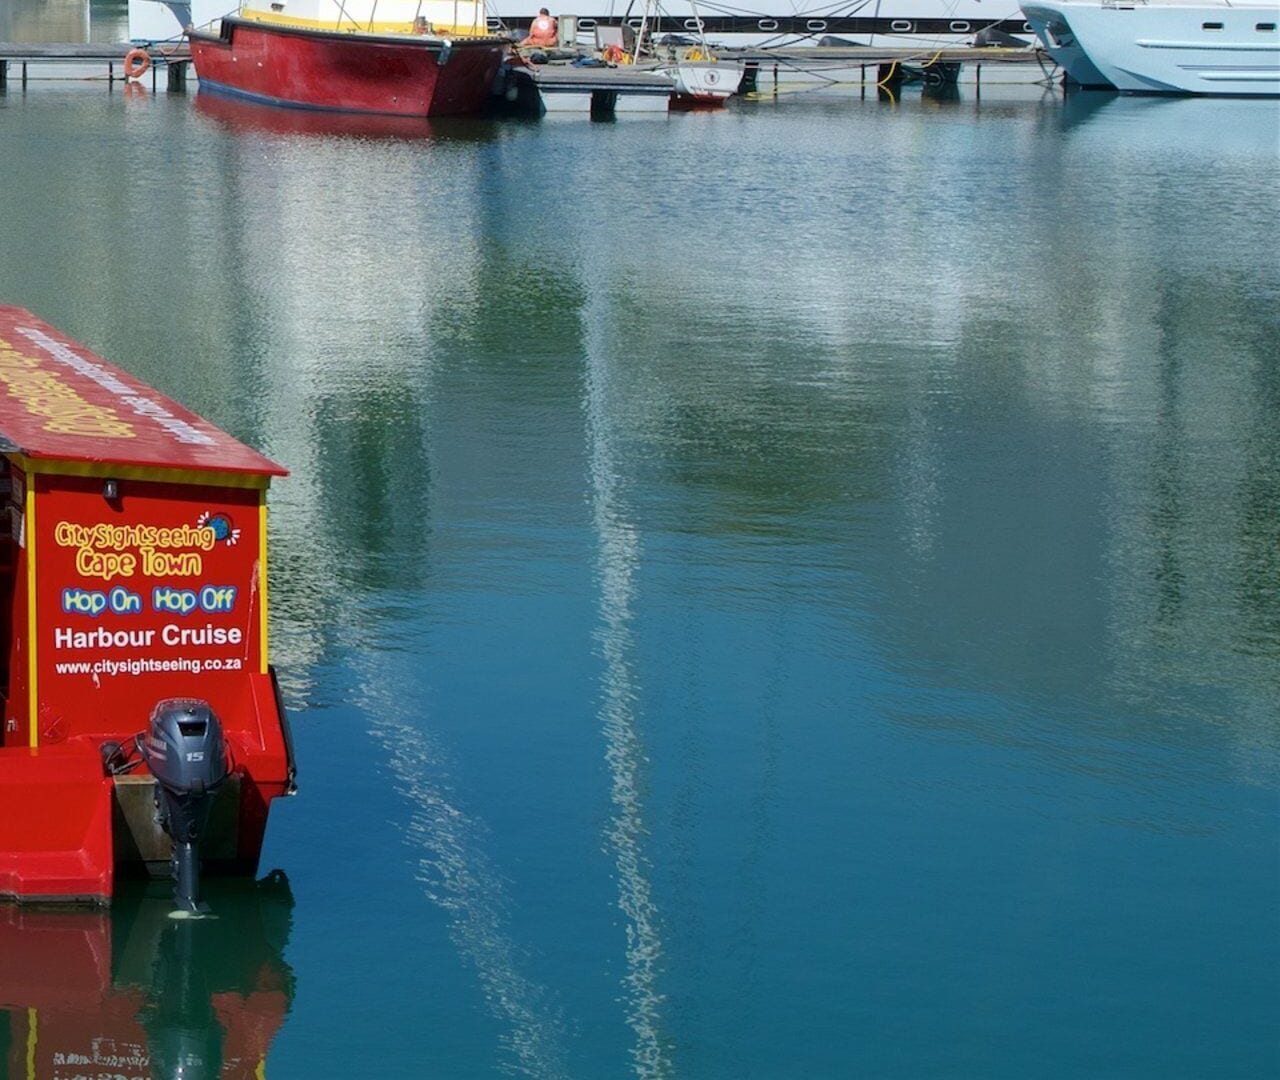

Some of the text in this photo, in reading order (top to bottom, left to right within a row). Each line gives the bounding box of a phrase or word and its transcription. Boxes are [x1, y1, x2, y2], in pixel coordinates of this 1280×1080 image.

[54, 521, 216, 551] CitySightseeing
[76, 546, 202, 581] Cape Town
[62, 585, 236, 614] Hop On Hop Off
[54, 624, 242, 649] Harbour Cruise
[55, 658, 242, 676] www.citysightseeing.co.za
[186, 751, 204, 762] 15
